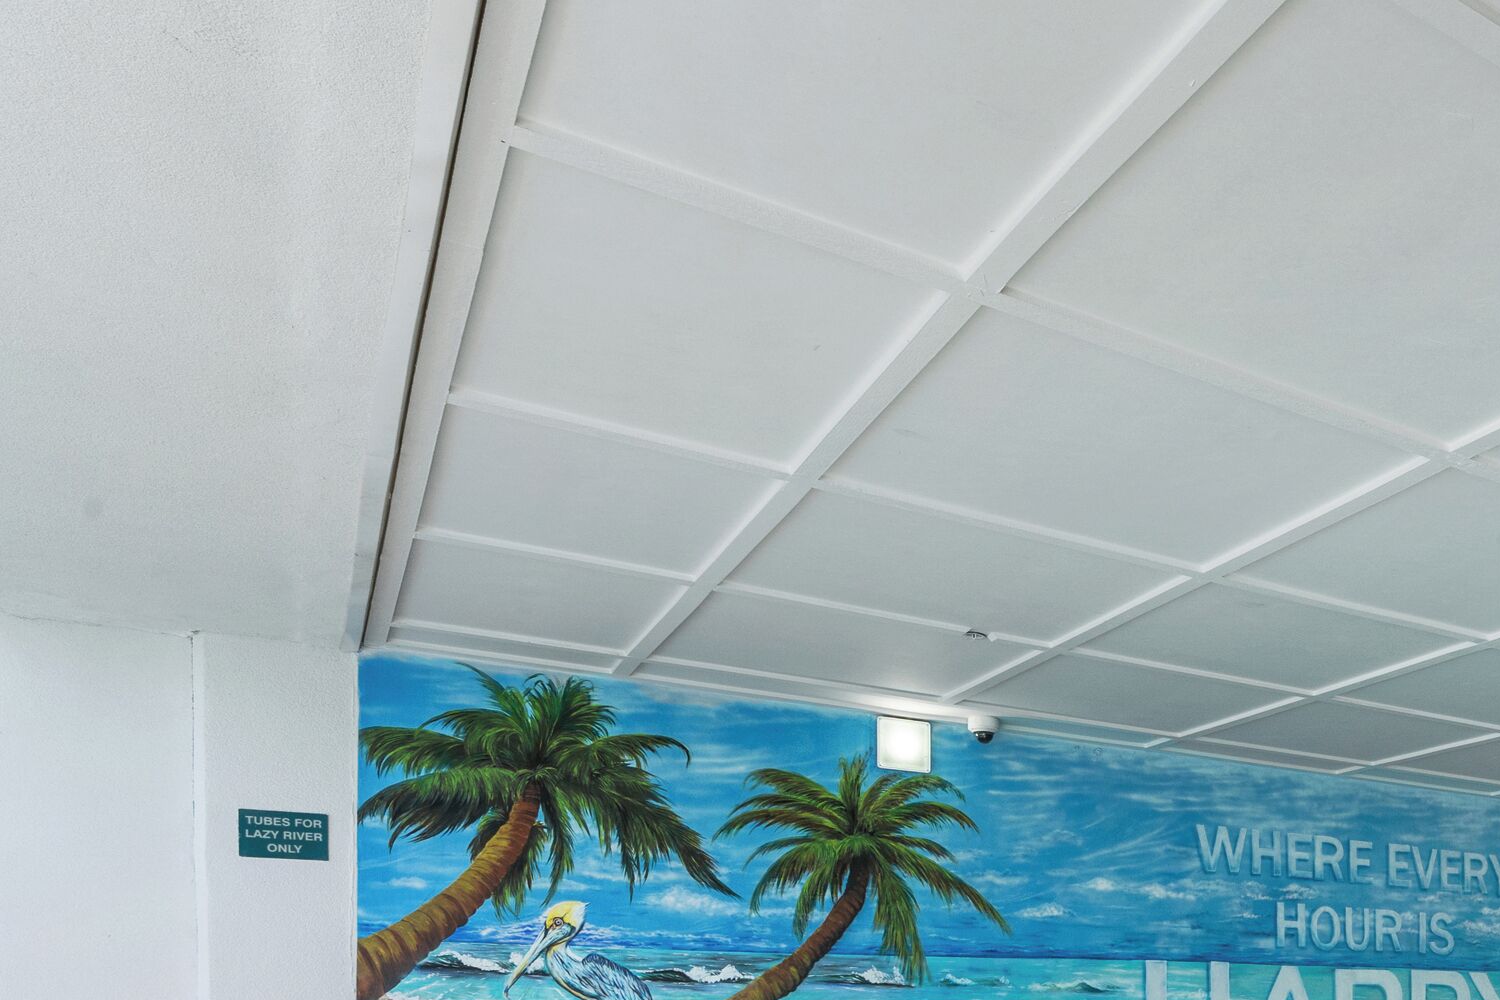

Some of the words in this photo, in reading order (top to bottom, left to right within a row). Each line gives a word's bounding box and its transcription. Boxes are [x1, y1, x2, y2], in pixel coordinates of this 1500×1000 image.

[245, 815, 290, 827] TUBES
[294, 818, 322, 829] FOR
[245, 828, 279, 839] LAZY
[283, 830, 323, 841] RIVER
[266, 843, 303, 853] ONLY
[1196, 823, 1374, 884] WHERE
[1275, 901, 1401, 952] HOUR
[1418, 911, 1455, 955] IS
